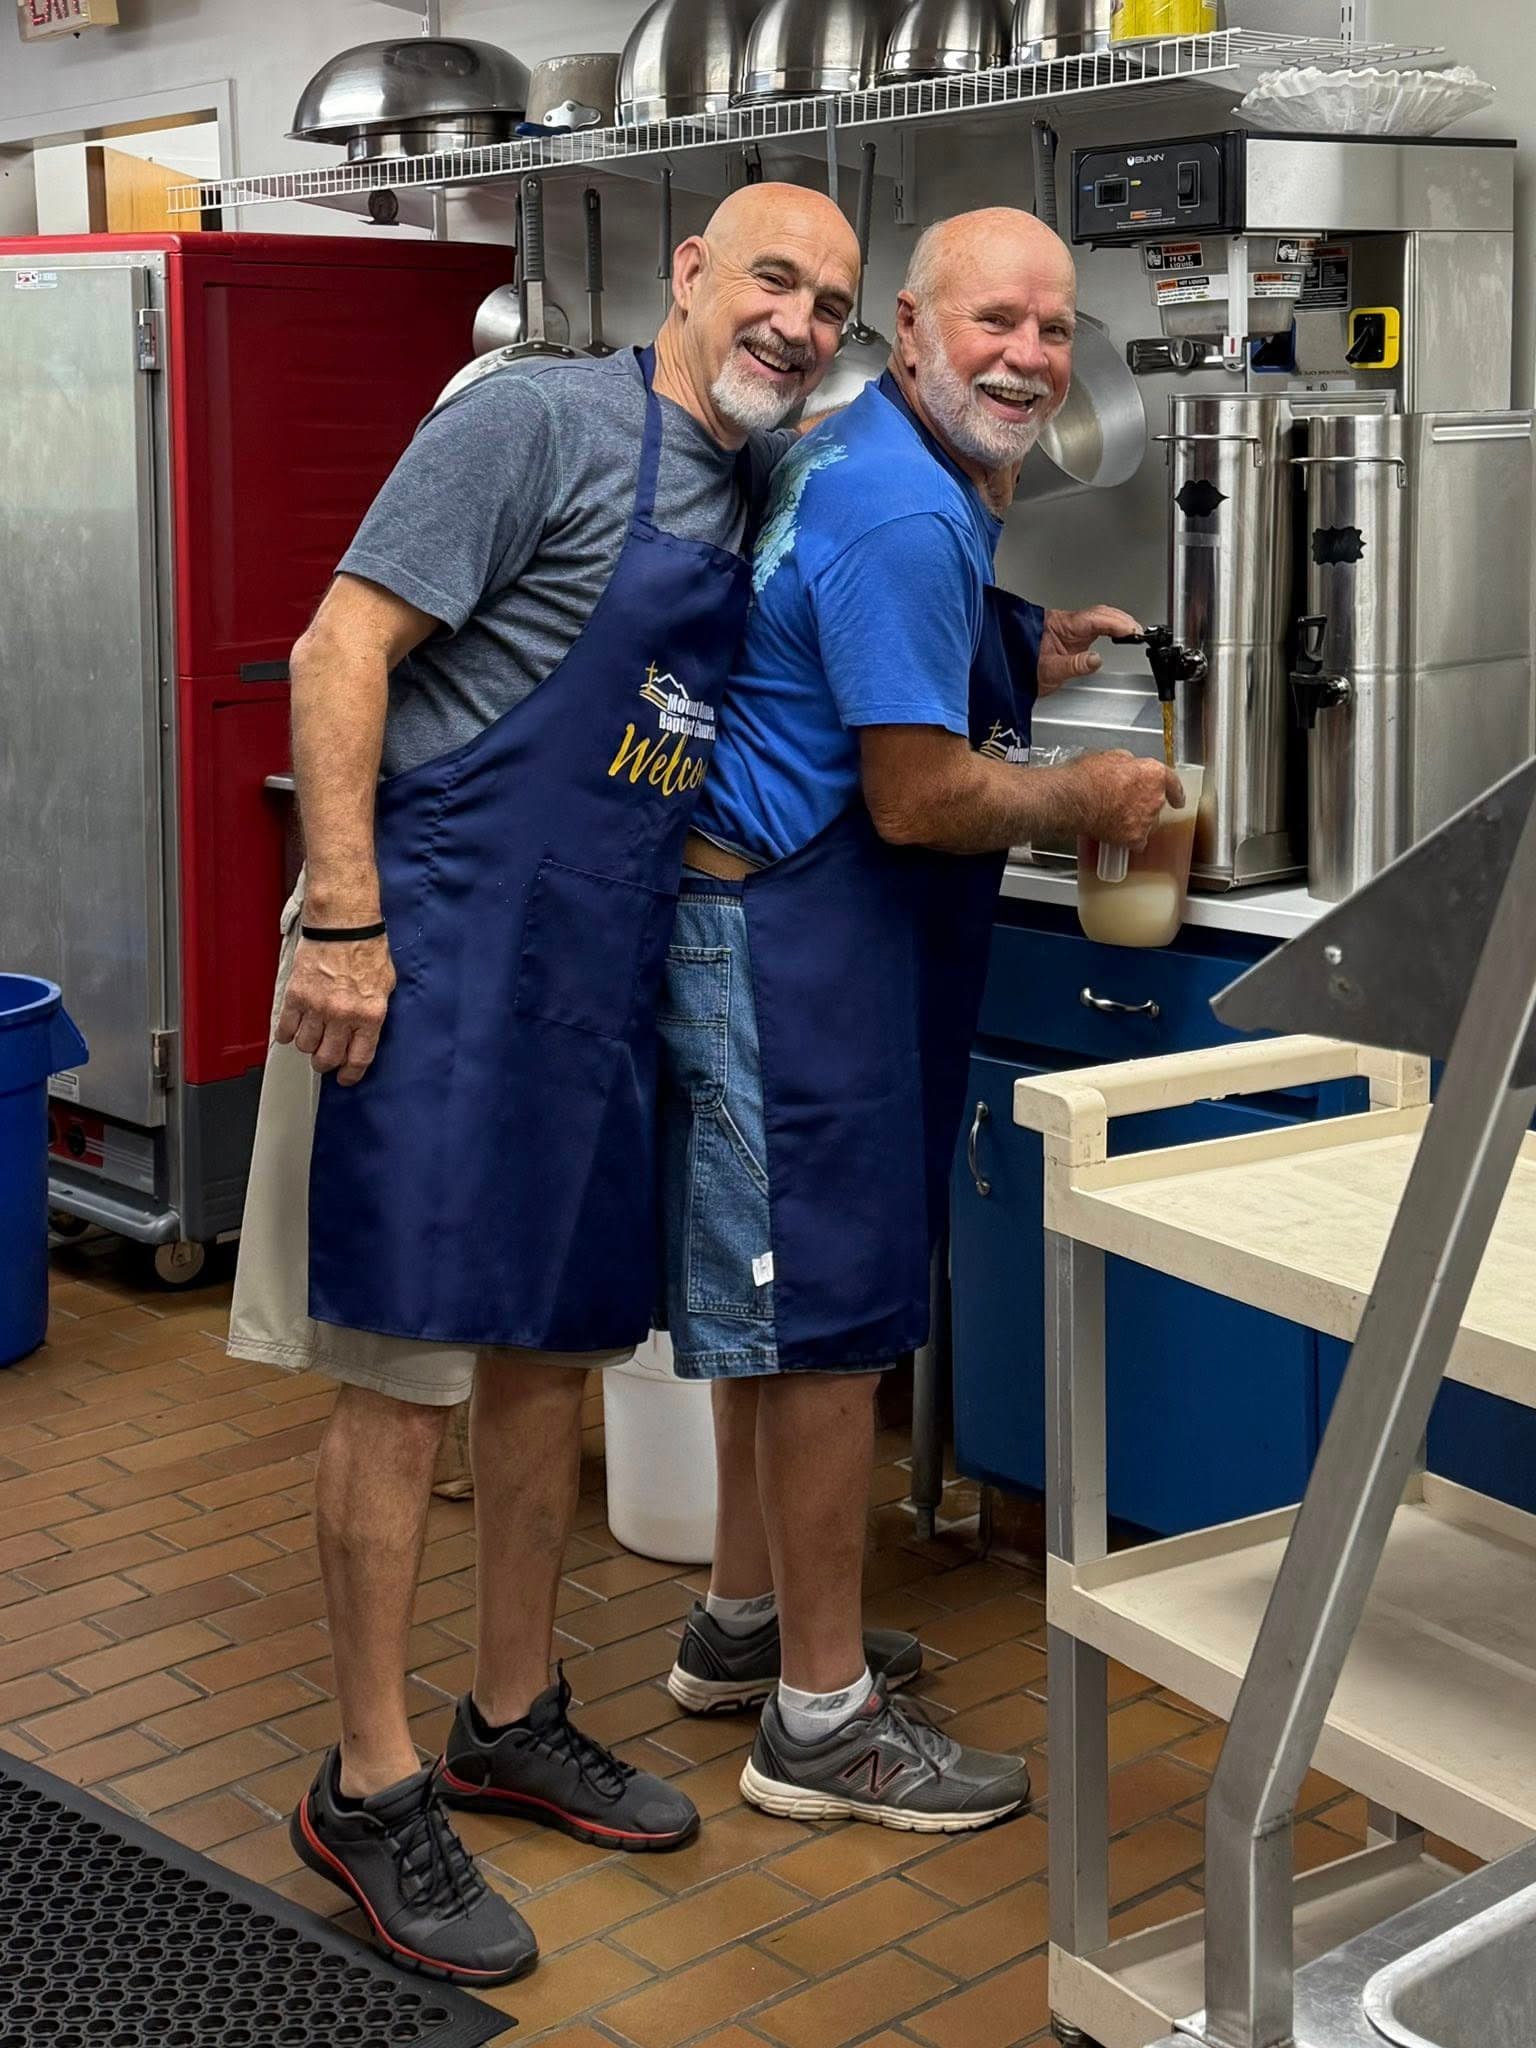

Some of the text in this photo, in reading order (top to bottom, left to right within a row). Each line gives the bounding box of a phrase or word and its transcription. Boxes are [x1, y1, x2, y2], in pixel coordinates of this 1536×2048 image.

[1134, 153, 1165, 165] BUNN
[1169, 254, 1193, 263] HOT
[608, 723, 708, 796] Welco
[804, 1692, 849, 1712] NB
